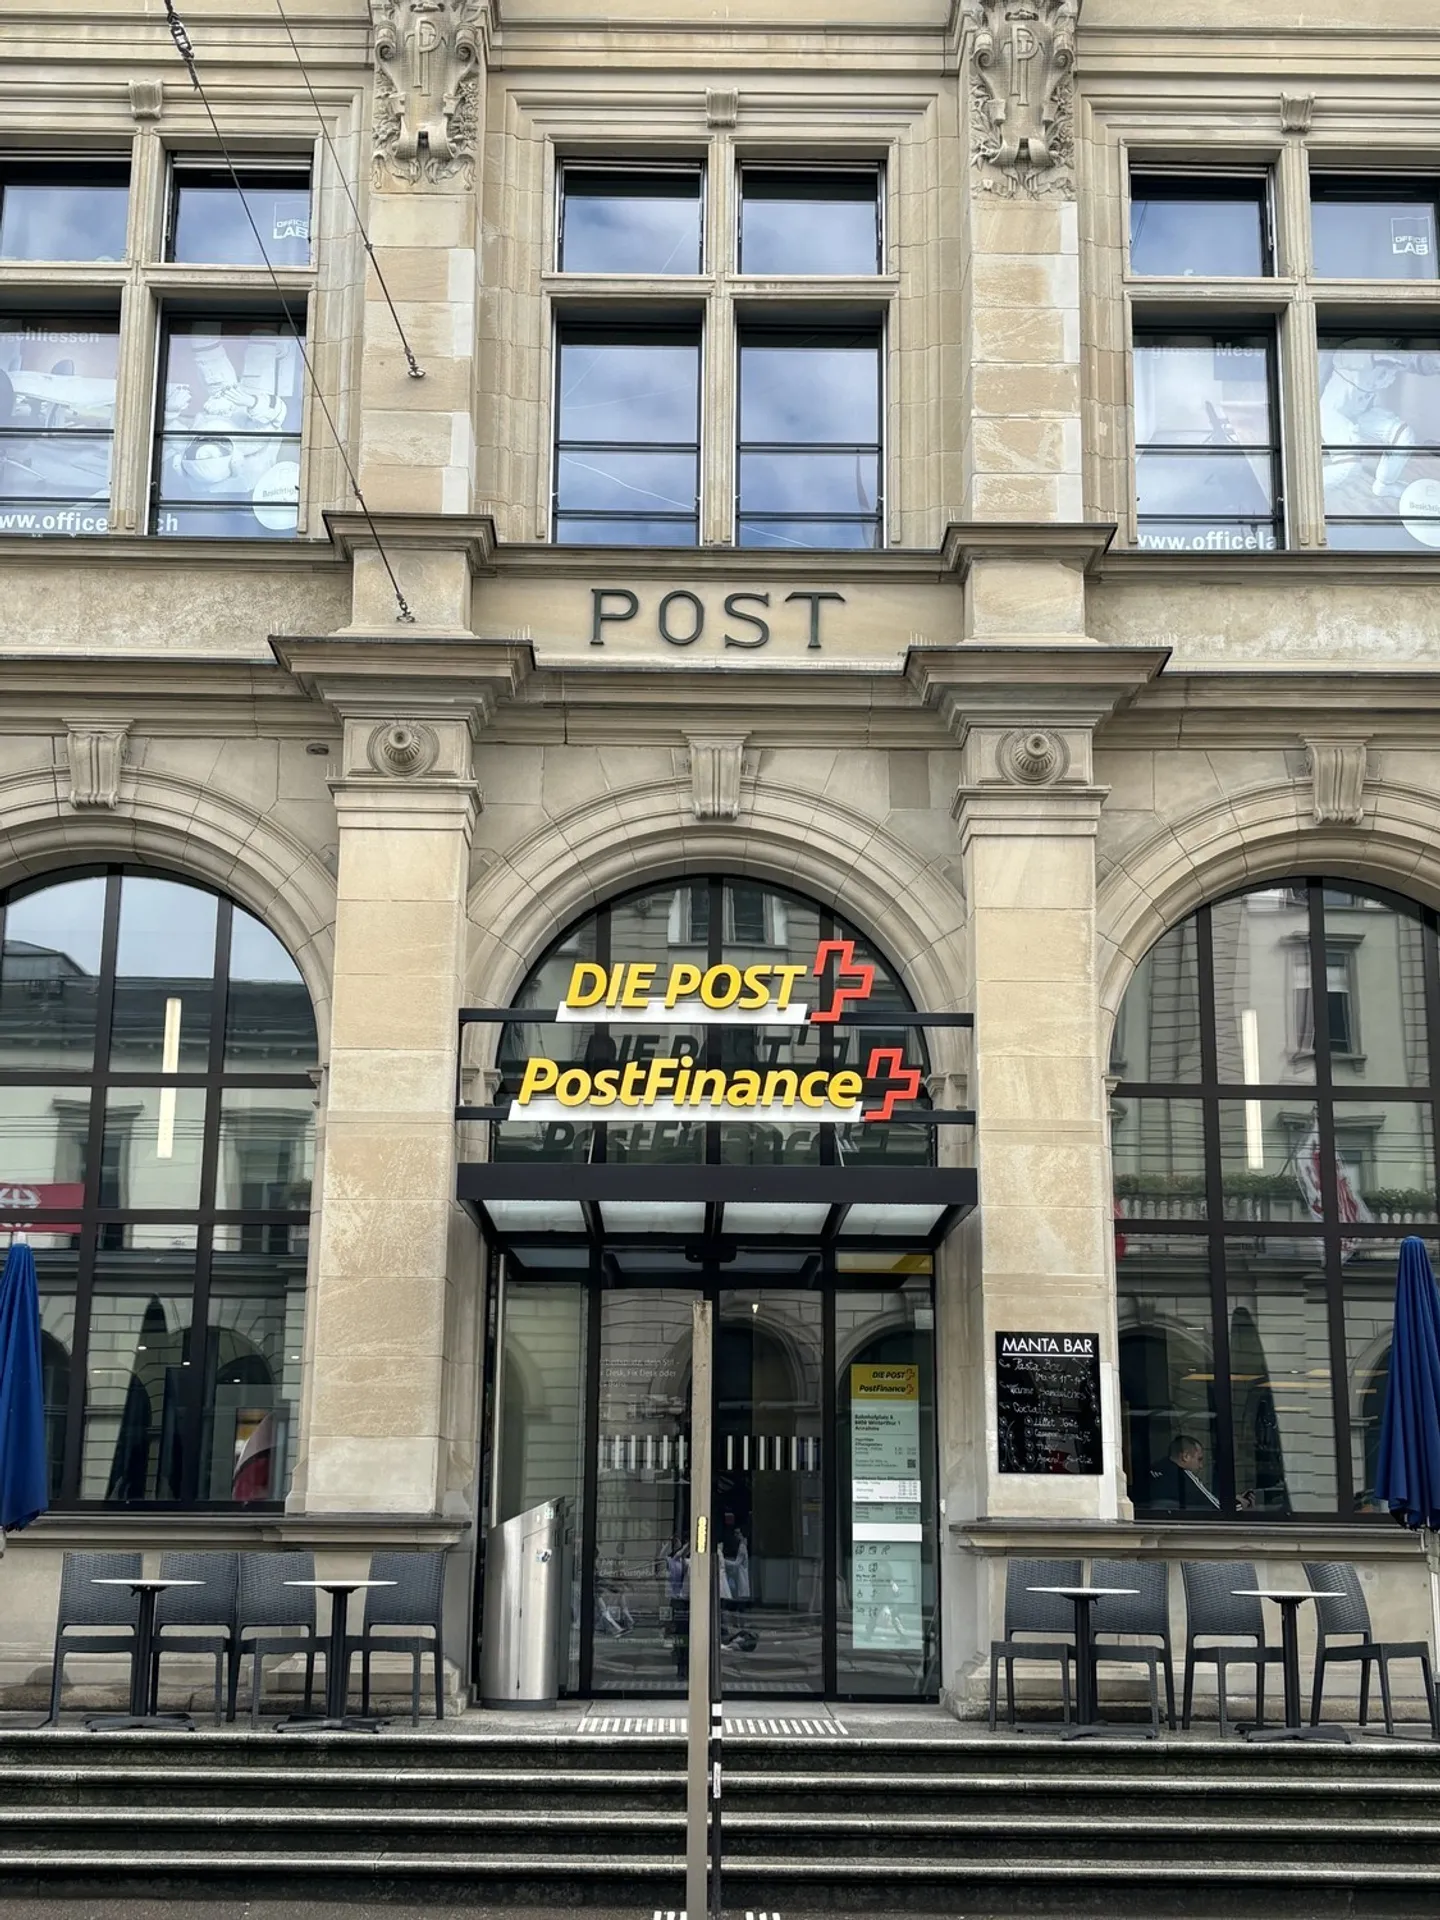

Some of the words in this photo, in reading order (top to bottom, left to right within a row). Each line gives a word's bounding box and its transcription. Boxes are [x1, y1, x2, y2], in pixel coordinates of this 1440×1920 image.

[273, 226, 308, 240] LAB
[1392, 242, 1429, 256] LAB
[590, 588, 846, 649] POST
[565, 961, 657, 1009] DIE
[664, 963, 808, 1010] POST
[518, 1055, 863, 1108] PostFinance
[1002, 1337, 1060, 1352] MANTA
[1063, 1338, 1094, 1353] BAR
[872, 1370, 885, 1379] DIE
[886, 1370, 905, 1380] POST
[859, 1383, 906, 1393] PostFinance
